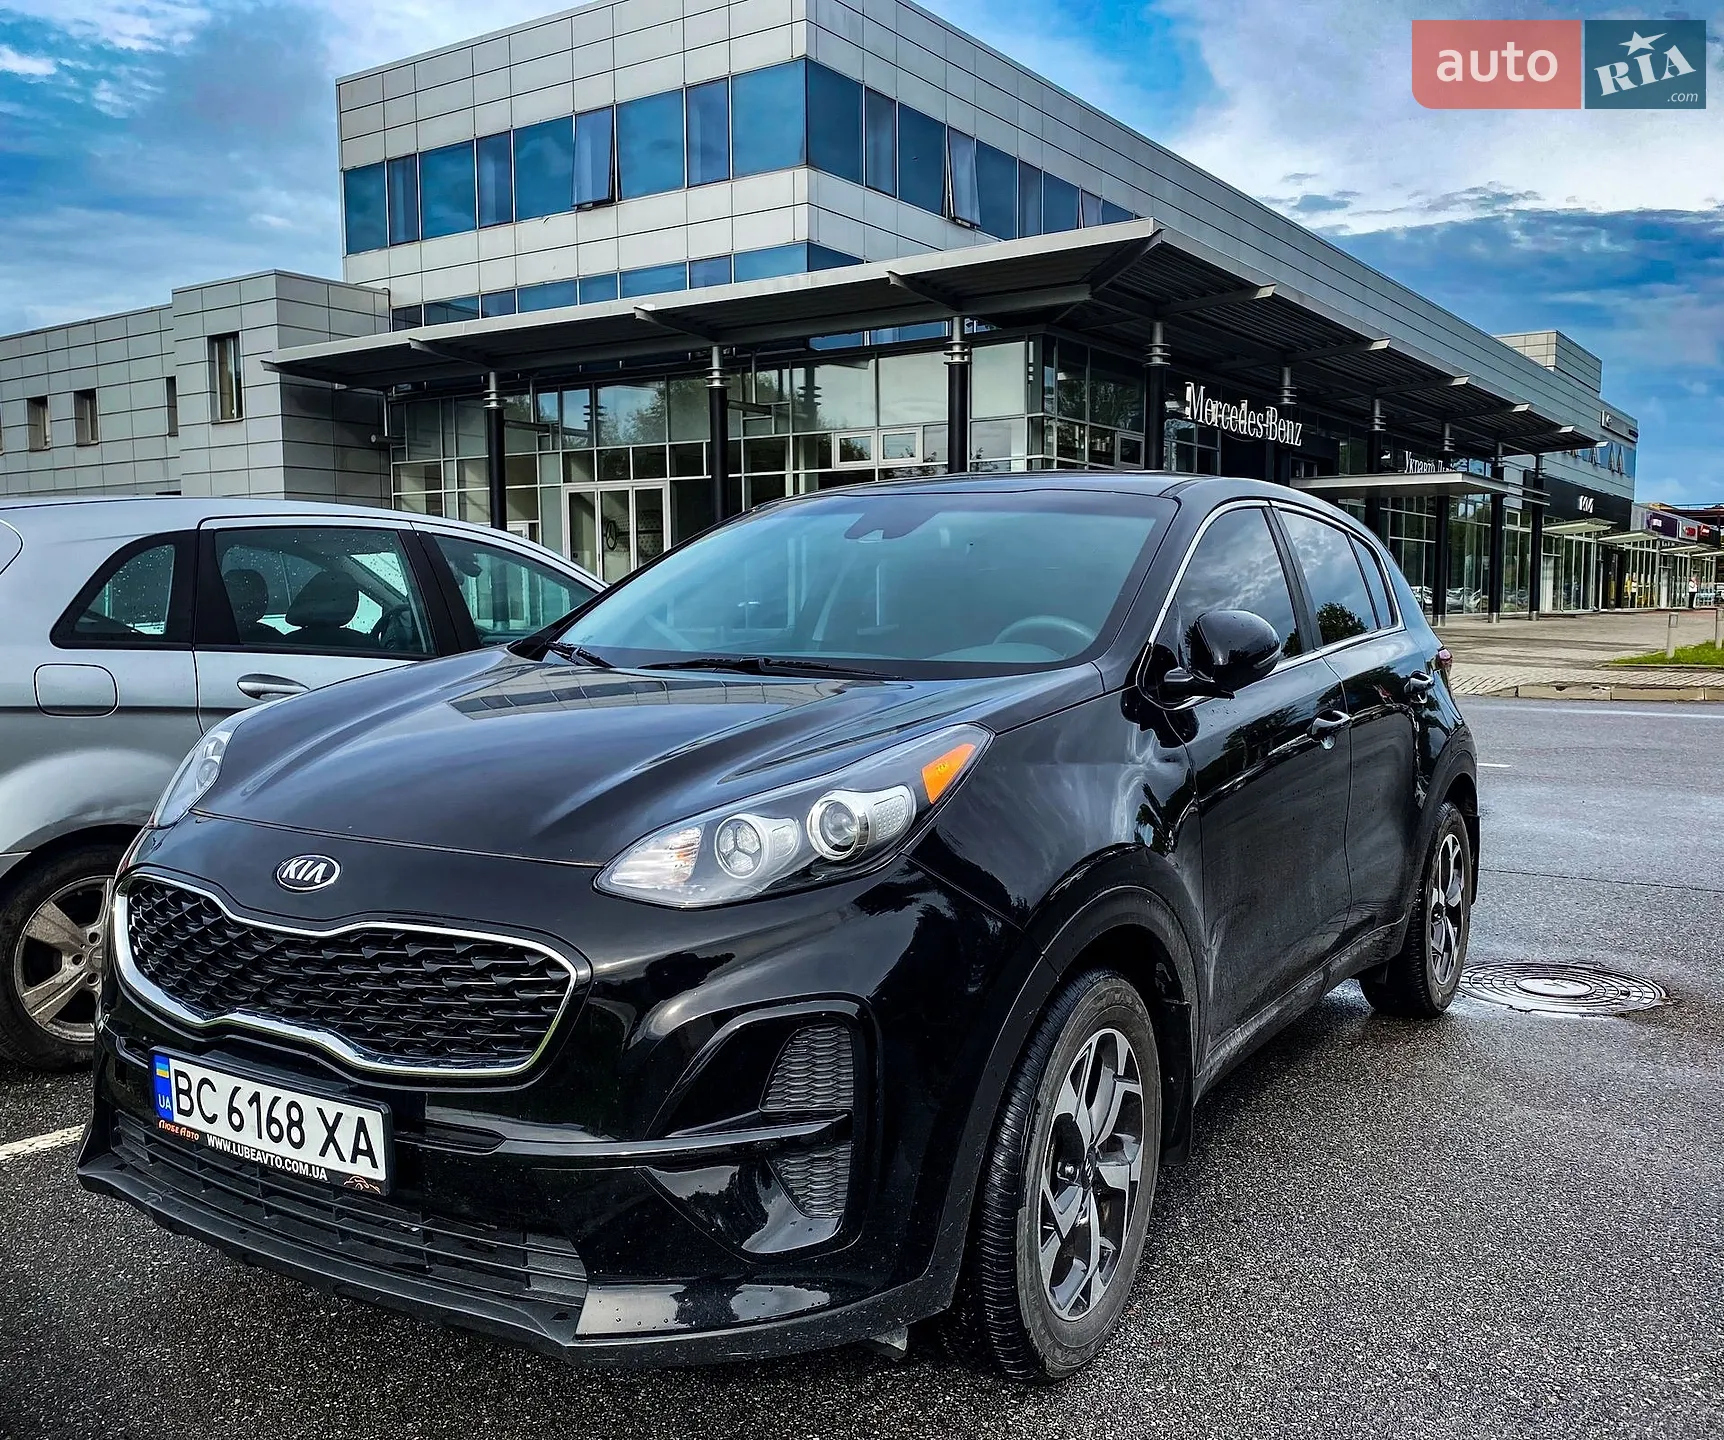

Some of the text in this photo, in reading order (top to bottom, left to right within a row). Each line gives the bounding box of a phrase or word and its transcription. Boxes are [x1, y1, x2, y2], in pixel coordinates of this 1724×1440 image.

[1184, 381, 1303, 447] Mercedes-Benz
[281, 858, 328, 884] KIA
[157, 1094, 172, 1111] UA
[173, 1068, 379, 1170] BC 6168 XA
[206, 1133, 328, 1182] WWW.LUBEAVTO.COM.UA
